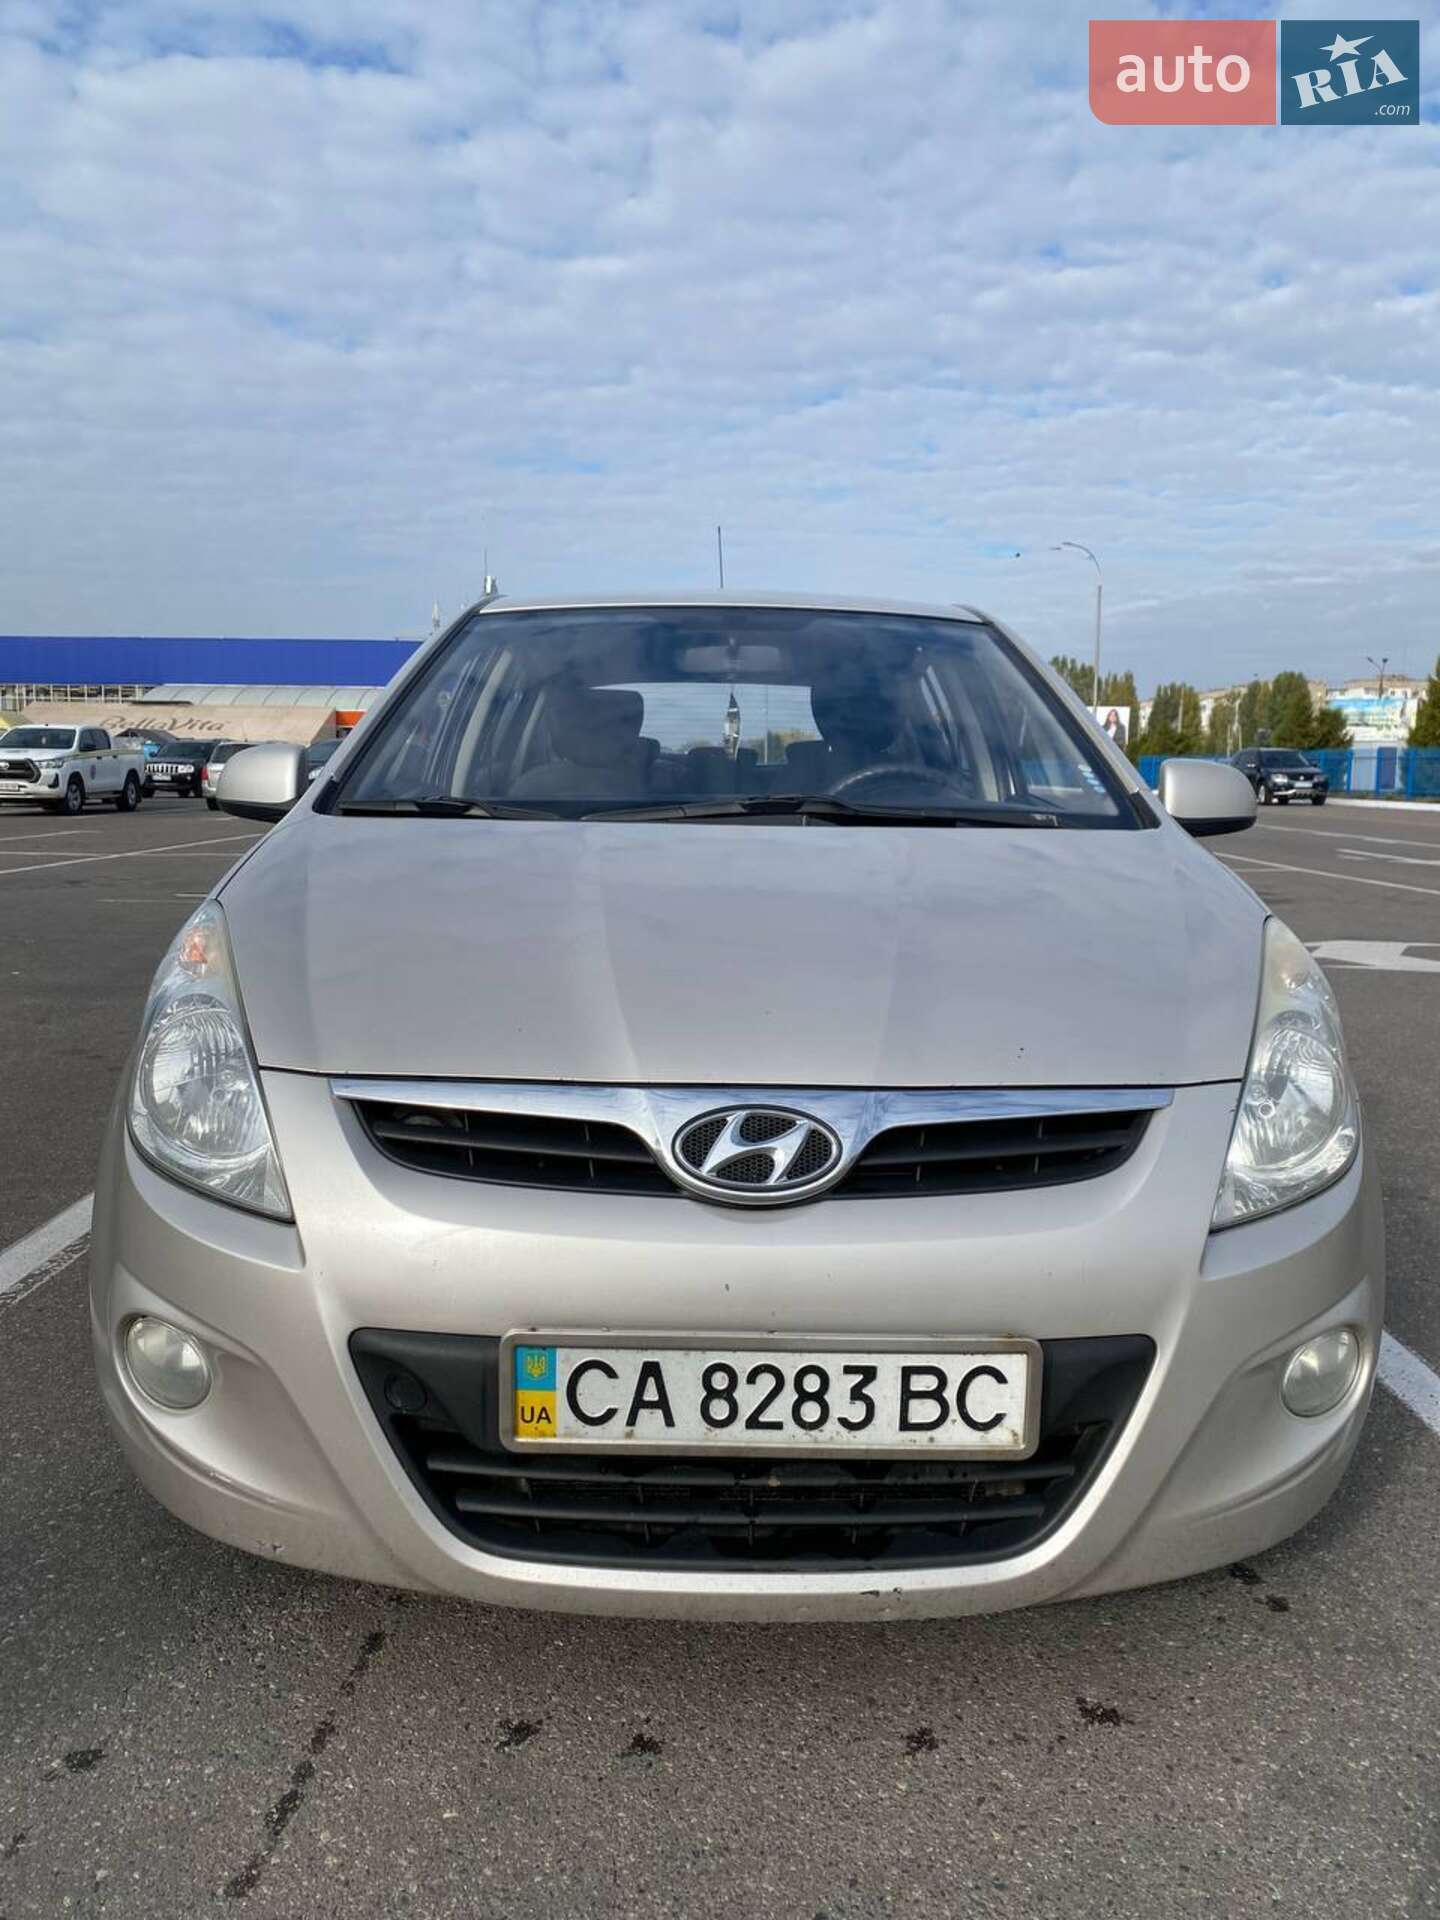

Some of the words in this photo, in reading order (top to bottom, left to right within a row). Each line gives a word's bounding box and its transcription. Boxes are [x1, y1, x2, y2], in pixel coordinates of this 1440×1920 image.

[520, 1406, 552, 1425] UA
[566, 1359, 675, 1428] CA
[700, 1361, 878, 1432] 8283
[898, 1364, 1009, 1432] BC
